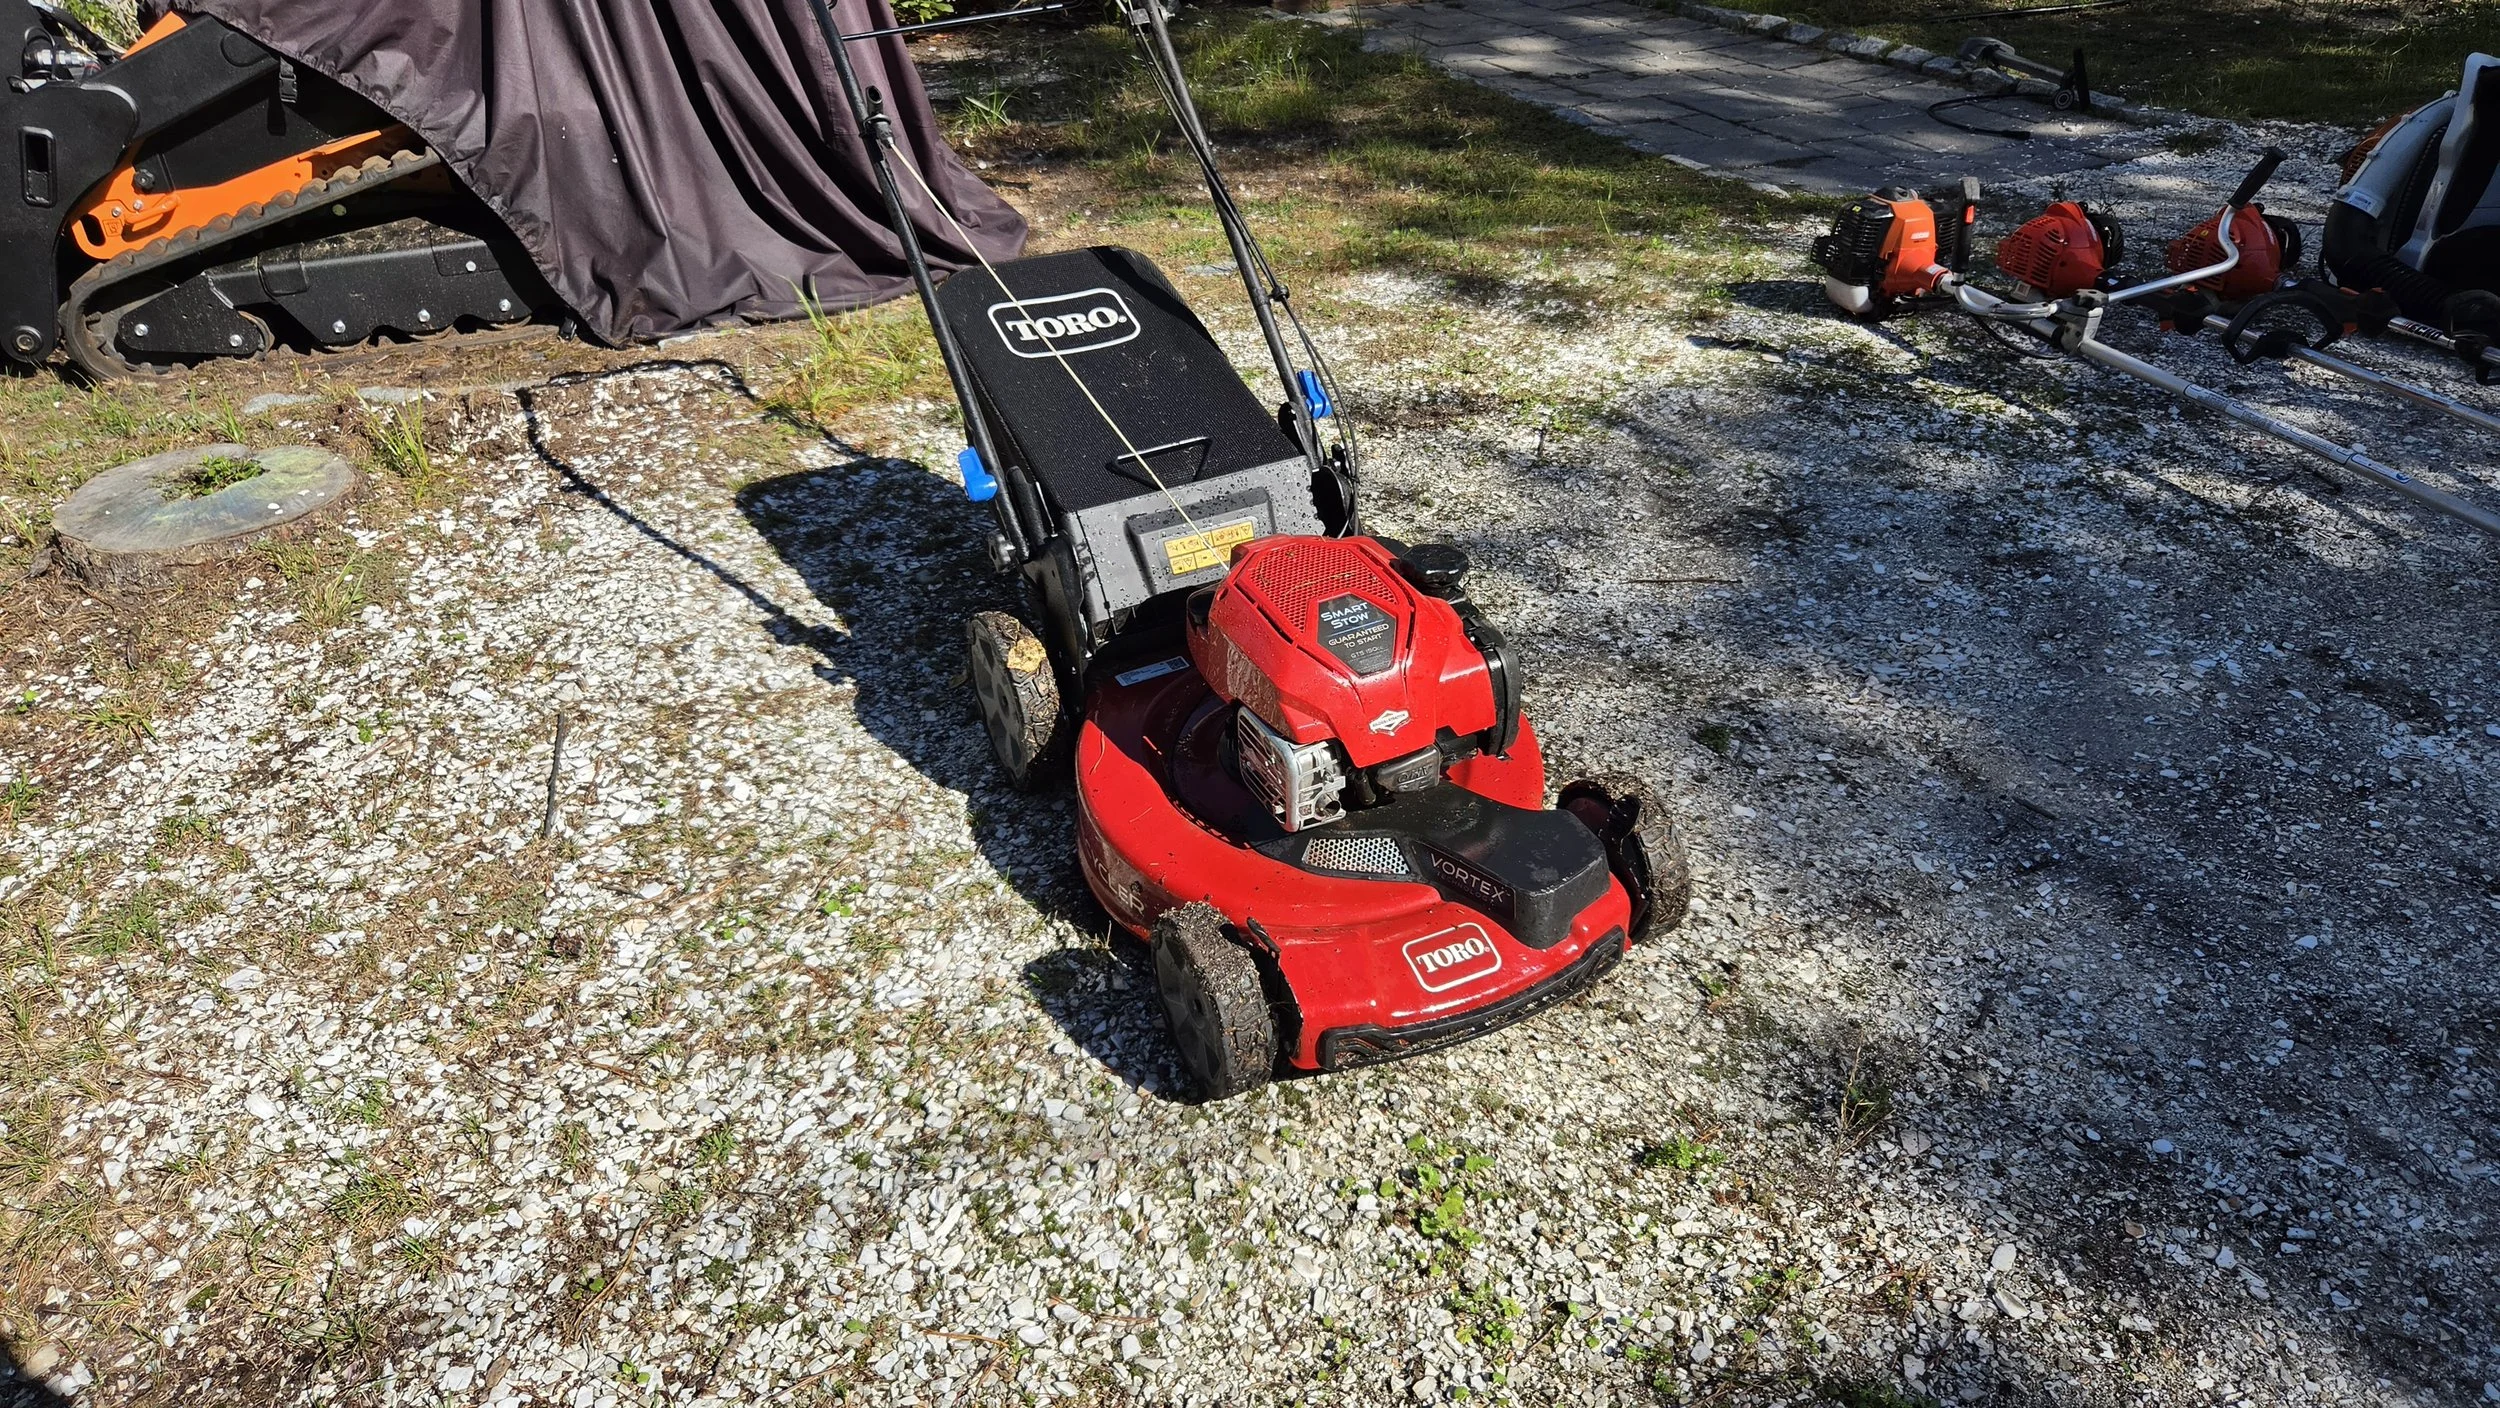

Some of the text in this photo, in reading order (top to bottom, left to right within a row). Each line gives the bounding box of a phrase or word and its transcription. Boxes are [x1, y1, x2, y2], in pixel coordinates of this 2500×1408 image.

[1005, 307, 1119, 341] TORO
[1321, 602, 1368, 621] SMART
[1331, 611, 1369, 629] STOW
[1328, 623, 1389, 646] GUARANTEED
[1357, 633, 1382, 645] START
[1430, 853, 1505, 902] VORTEX
[1416, 938, 1484, 972] TORO
